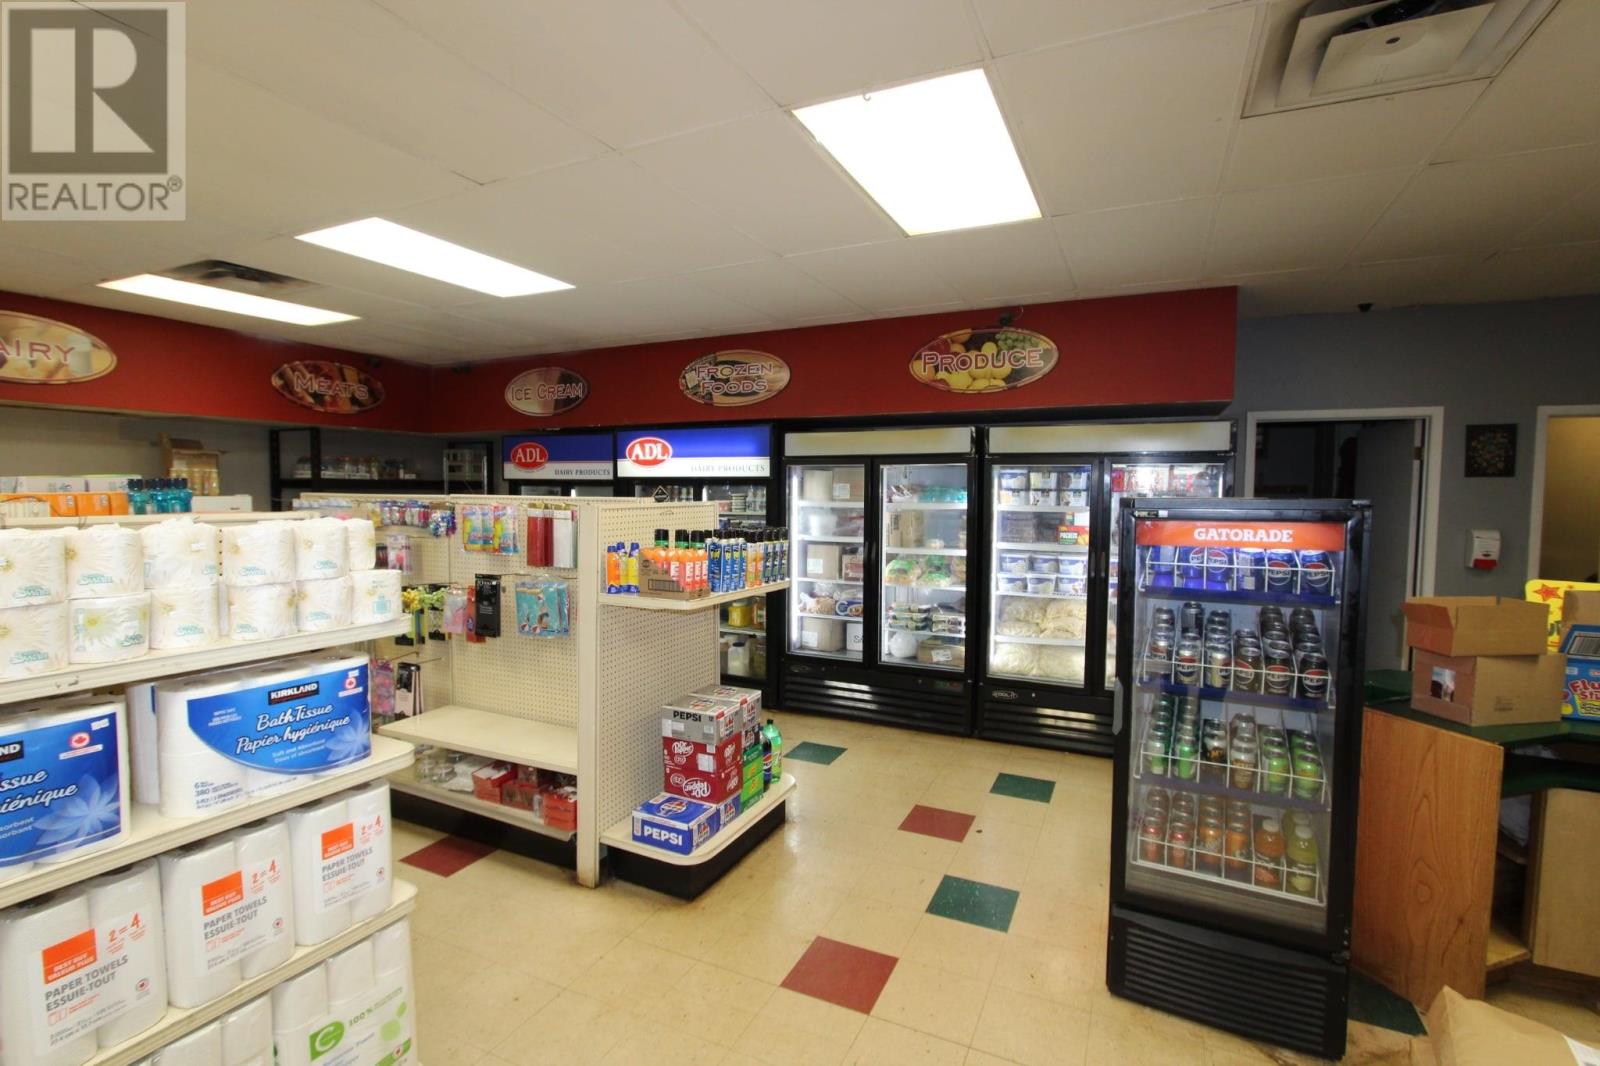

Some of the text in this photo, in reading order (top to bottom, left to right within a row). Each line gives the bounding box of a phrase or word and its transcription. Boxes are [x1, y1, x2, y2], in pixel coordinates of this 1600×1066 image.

[697, 363, 773, 379] FROZEN
[921, 348, 1044, 374] PRODUCE
[293, 371, 370, 401] MEATS
[511, 382, 583, 401] ICE CREAM
[701, 379, 769, 395] FOODS
[515, 447, 545, 463] ADL
[631, 443, 669, 461] ADL
[554, 468, 611, 476] DAIRY PRODUCTS
[718, 464, 766, 473] PRODUCTS
[1193, 528, 1294, 543] GATORADE
[270, 683, 318, 700] KIRKLAND
[257, 708, 295, 731] Bath
[294, 704, 333, 721] Tissue
[673, 710, 702, 723] PEPSI
[236, 716, 351, 755] Papier hygiénique
[644, 825, 683, 846] PEPSI
[322, 858, 345, 874] PAPER
[346, 846, 373, 863] TOWELS
[322, 858, 365, 882] ESSUIE-TOUT
[130, 912, 141, 928] 4
[204, 896, 268, 931] PAPER TOWELS
[205, 910, 258, 940] ESSUIE-TOUT
[45, 954, 129, 1001] PAPER TOWELS
[46, 971, 117, 1012] ESSUIE-TOUT
